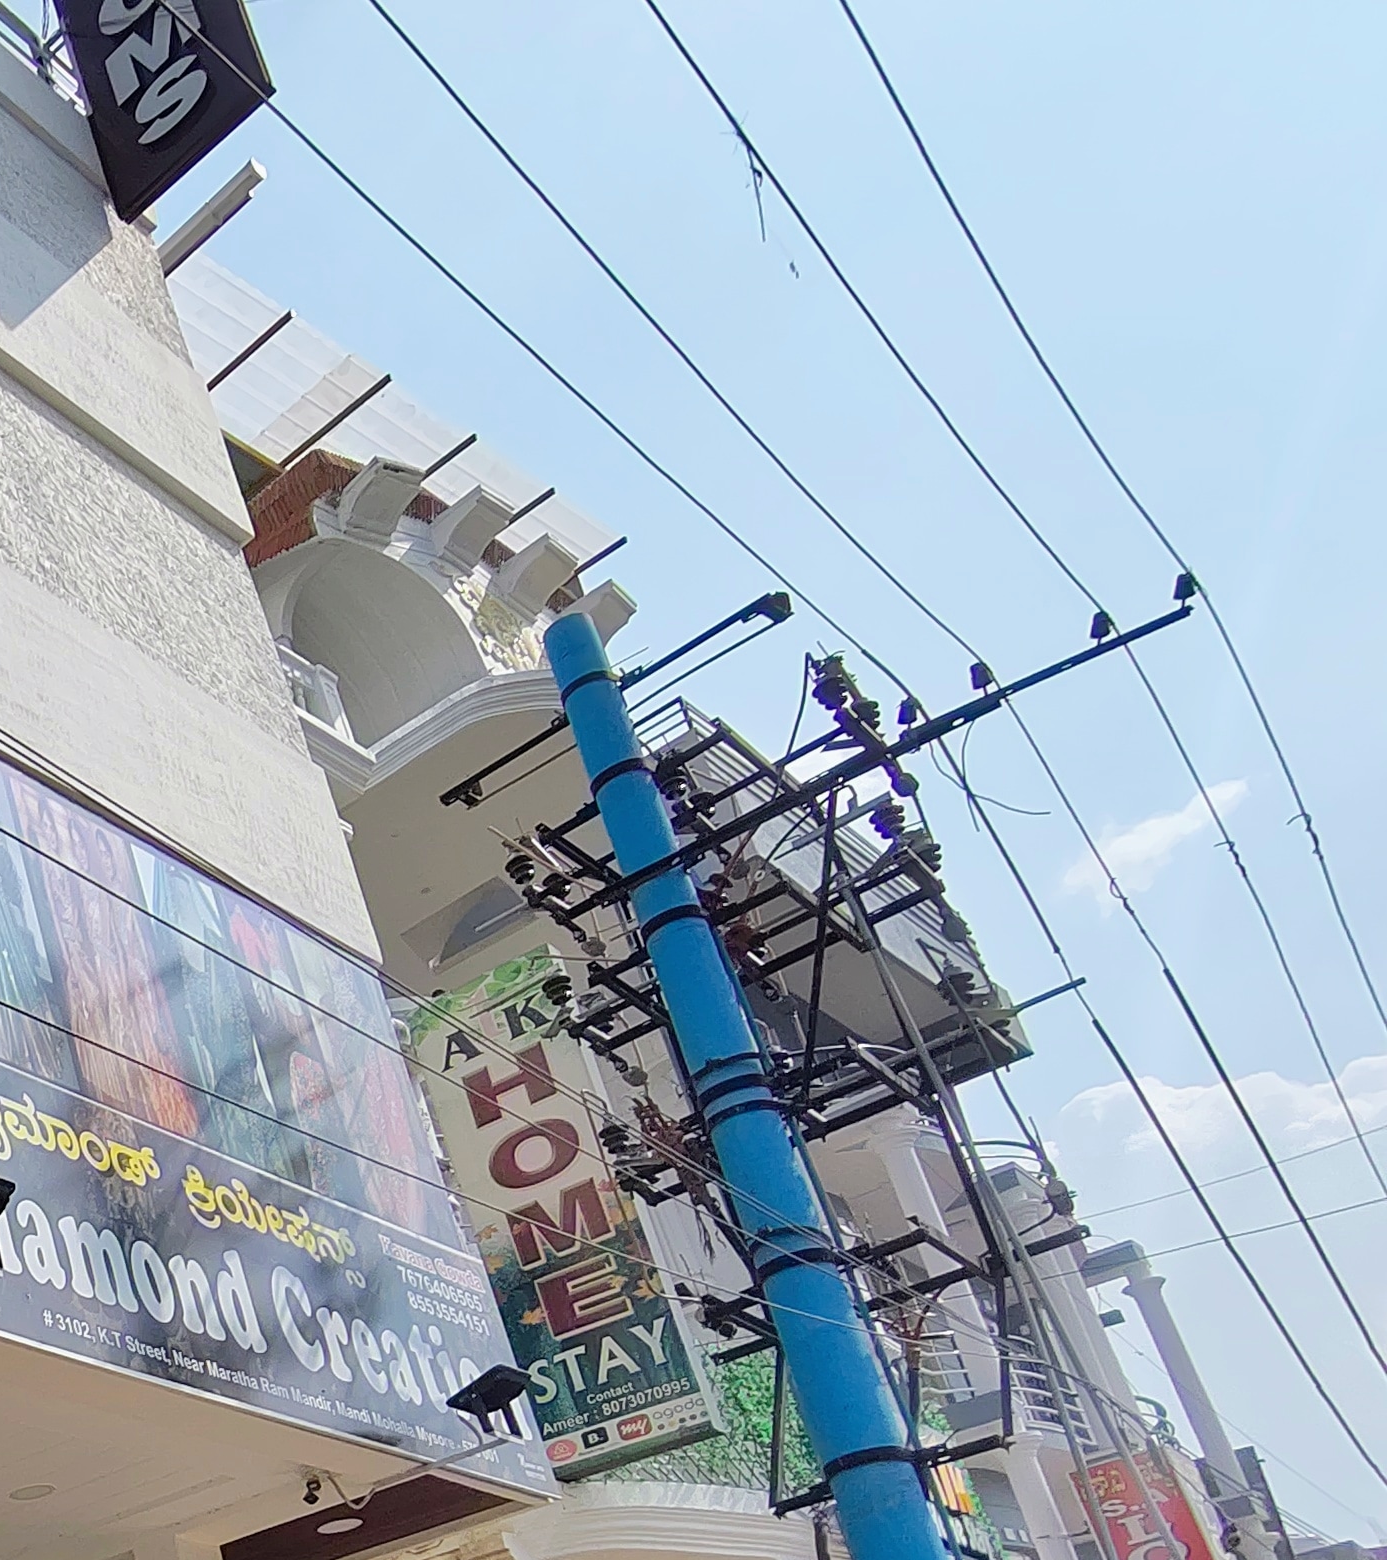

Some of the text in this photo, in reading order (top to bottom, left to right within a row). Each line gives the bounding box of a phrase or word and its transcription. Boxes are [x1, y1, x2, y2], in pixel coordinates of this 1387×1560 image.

[462, 1043, 633, 1341] HOME
[396, 1264, 483, 1312] 7676406565
[407, 1290, 491, 1336] 8553554151
[56, 1313, 97, 1344] 3102,
[97, 1326, 122, 1350] K.T
[126, 1335, 171, 1366] Street,
[172, 1350, 205, 1374] Near
[207, 1359, 259, 1390] Maratha
[261, 1377, 289, 1400] Ram
[290, 1386, 336, 1418] Mandir,
[337, 1401, 372, 1424] Mandi
[372, 1411, 415, 1437] Mohalla
[414, 1425, 456, 1452] Mysore
[269, 1264, 534, 1442] Creatio
[527, 1316, 669, 1405] STAY
[542, 1411, 591, 1436] Ameer
[601, 1377, 691, 1417] 8073070995
[586, 1381, 635, 1405] Contact
